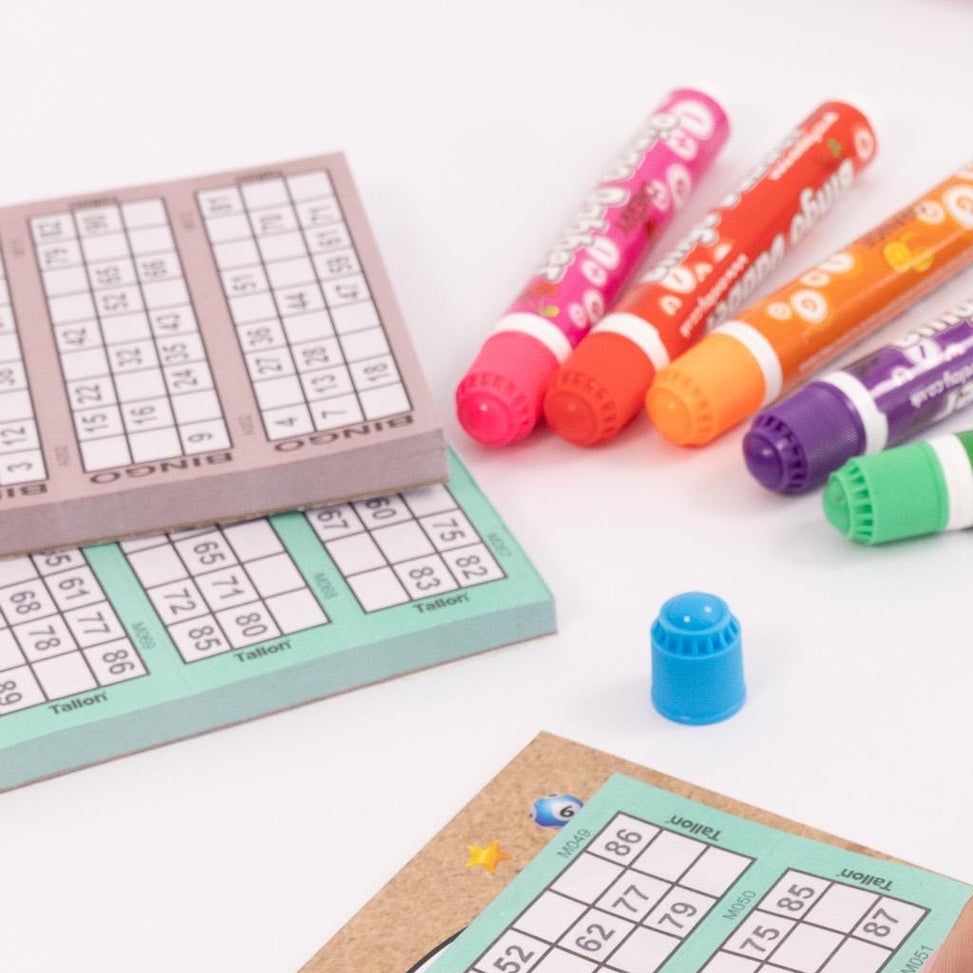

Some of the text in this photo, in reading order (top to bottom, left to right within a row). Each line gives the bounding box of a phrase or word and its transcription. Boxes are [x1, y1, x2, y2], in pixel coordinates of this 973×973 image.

[117, 347, 142, 367] 32
[165, 343, 190, 363] 35
[301, 346, 329, 366] 28
[61, 328, 108, 432] 15 22 42
[173, 369, 198, 388] 24
[247, 327, 299, 428] 4 27 36
[311, 374, 338, 393] 13
[363, 362, 390, 382] 18
[130, 406, 158, 424] 16
[321, 410, 347, 419] 7
[188, 432, 213, 444] 9
[273, 415, 414, 452] BINGO
[1, 426, 33, 473] 3 12
[89, 451, 234, 485] BINGO
[317, 509, 349, 529] 67
[365, 496, 441, 591] 60 83
[433, 518, 489, 580] 75 82
[193, 541, 268, 638] 65 71 80
[414, 592, 470, 615] Tallon
[9, 590, 62, 651] 68 78
[42, 551, 136, 675] 5 61 77 86
[164, 588, 222, 651] 72 85
[234, 640, 293, 664] Tallon
[48, 692, 108, 715] Tallon
[560, 805, 575, 818] 6
[670, 815, 722, 842] Tallon
[557, 829, 591, 859] M049
[840, 868, 895, 892] Tallon
[493, 946, 534, 973] 52
[605, 829, 642, 856] 86
[723, 890, 757, 921] M050
[576, 924, 615, 951] 62
[612, 885, 648, 912] 77
[658, 903, 697, 928] 79
[740, 926, 779, 952] 75
[777, 885, 814, 911] 85
[863, 908, 898, 937] 87
